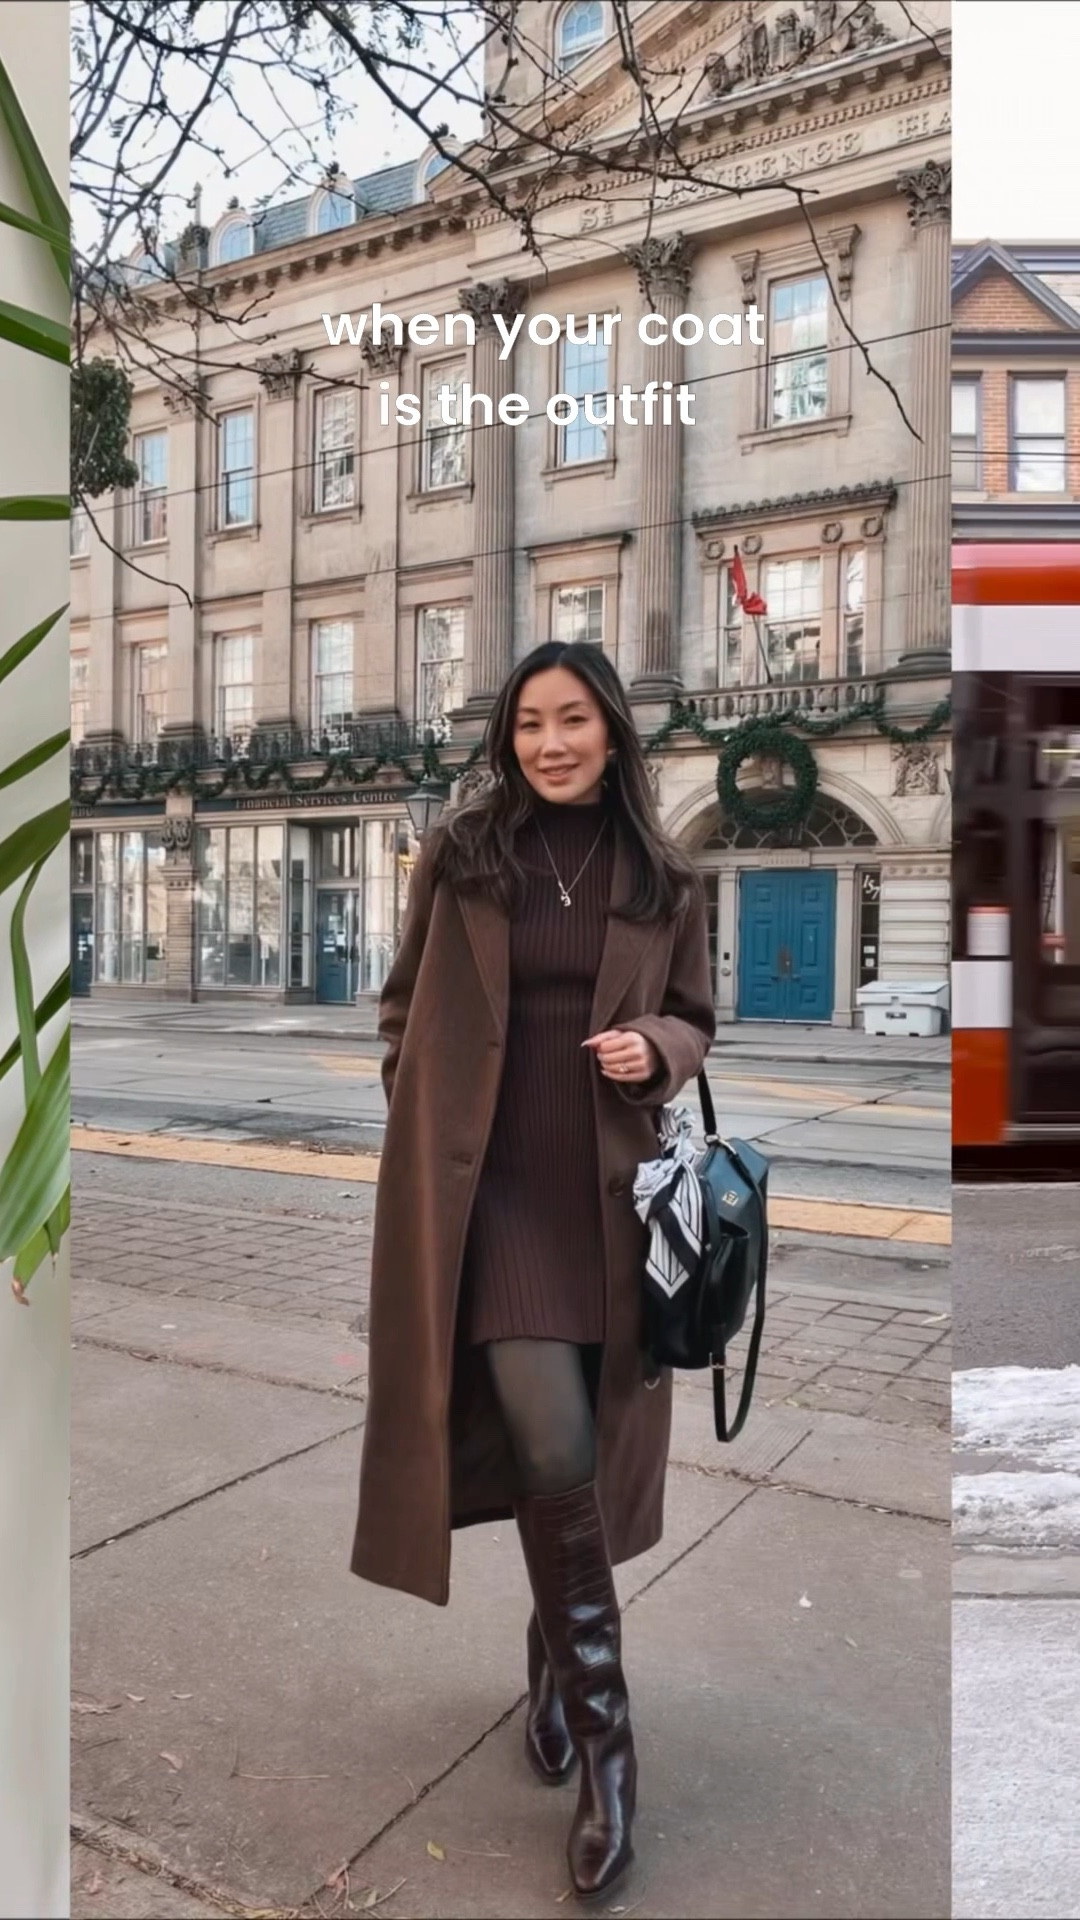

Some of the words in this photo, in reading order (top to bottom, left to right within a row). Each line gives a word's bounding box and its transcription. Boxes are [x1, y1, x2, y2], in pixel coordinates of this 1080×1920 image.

[235, 796, 292, 810] Financial
[295, 793, 348, 807] Services
[352, 790, 399, 804] Centre
